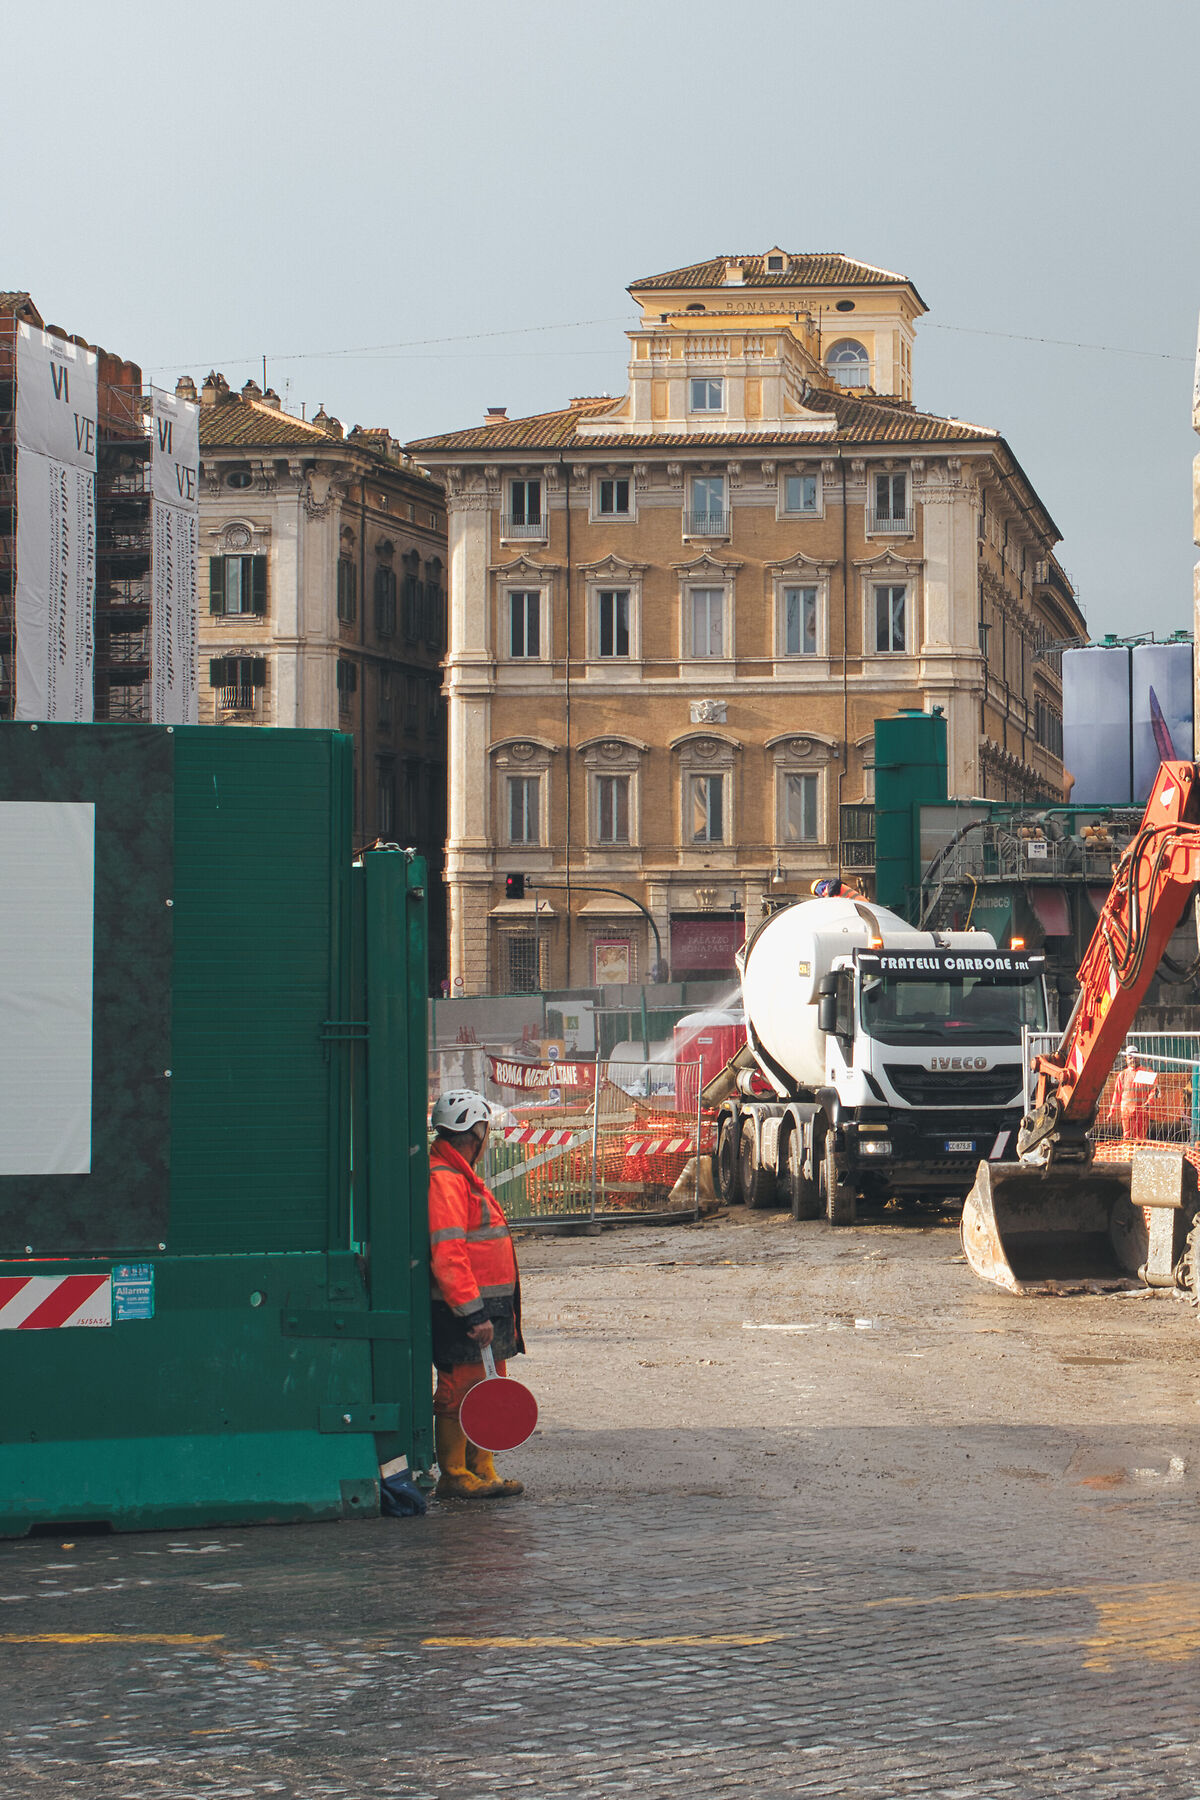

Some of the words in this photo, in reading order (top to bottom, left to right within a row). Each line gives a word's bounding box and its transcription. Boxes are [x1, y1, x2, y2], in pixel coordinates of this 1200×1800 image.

[50, 362, 69, 403] VI
[74, 412, 94, 456] VE
[158, 417, 172, 454] VI
[59, 467, 68, 512] Sala
[174, 462, 196, 502] VE
[58, 571, 68, 665] Battaglie
[85, 577, 94, 667] Battaglie
[880, 957, 940, 970] FRATELLI
[944, 958, 1012, 970] CARBONE
[1014, 962, 1030, 970] SRL
[496, 1062, 522, 1086] ROMA
[931, 1056, 988, 1070] IVECO
[116, 1287, 150, 1295] Allarme
